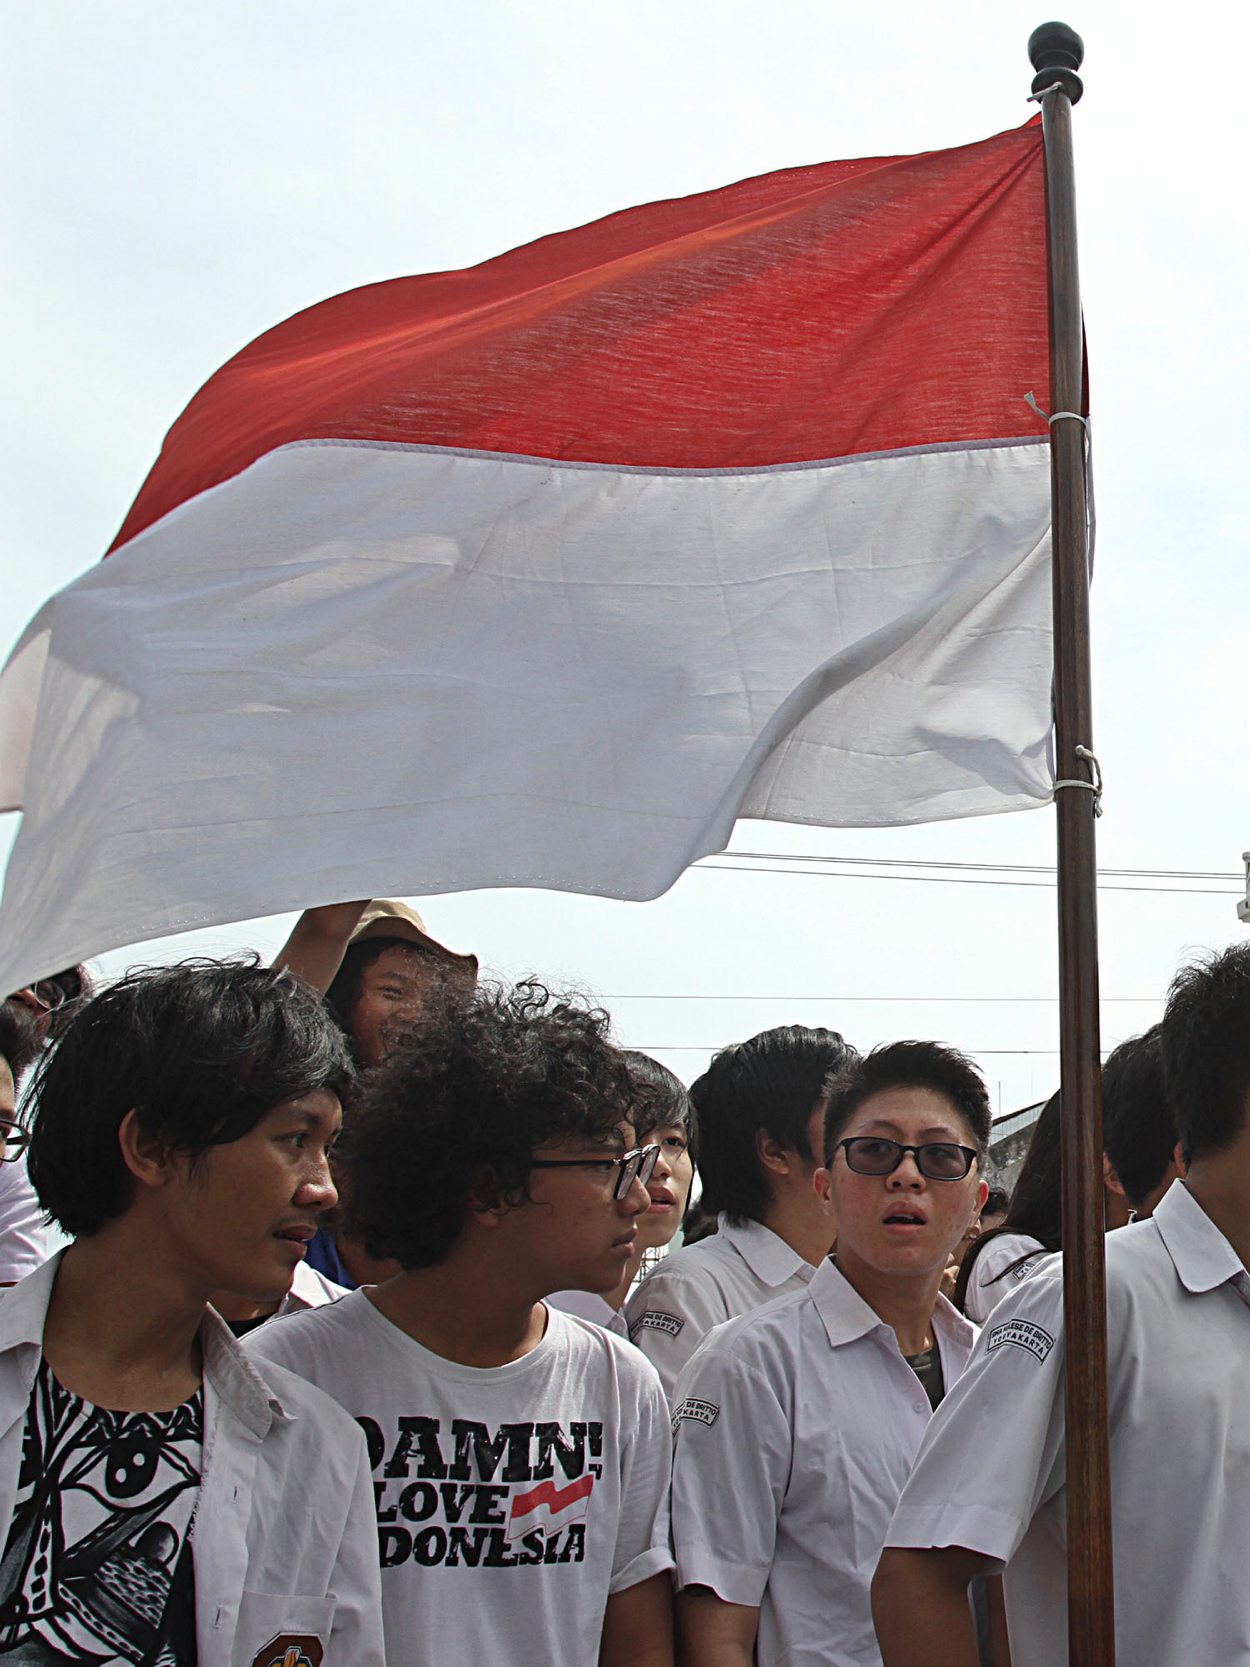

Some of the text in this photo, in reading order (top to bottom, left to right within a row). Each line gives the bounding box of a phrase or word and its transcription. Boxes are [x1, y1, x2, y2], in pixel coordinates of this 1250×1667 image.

[1024, 1325, 1034, 1335] DE
[374, 1481, 509, 1524] LOVE
[377, 1523, 586, 1568] DONESIA
